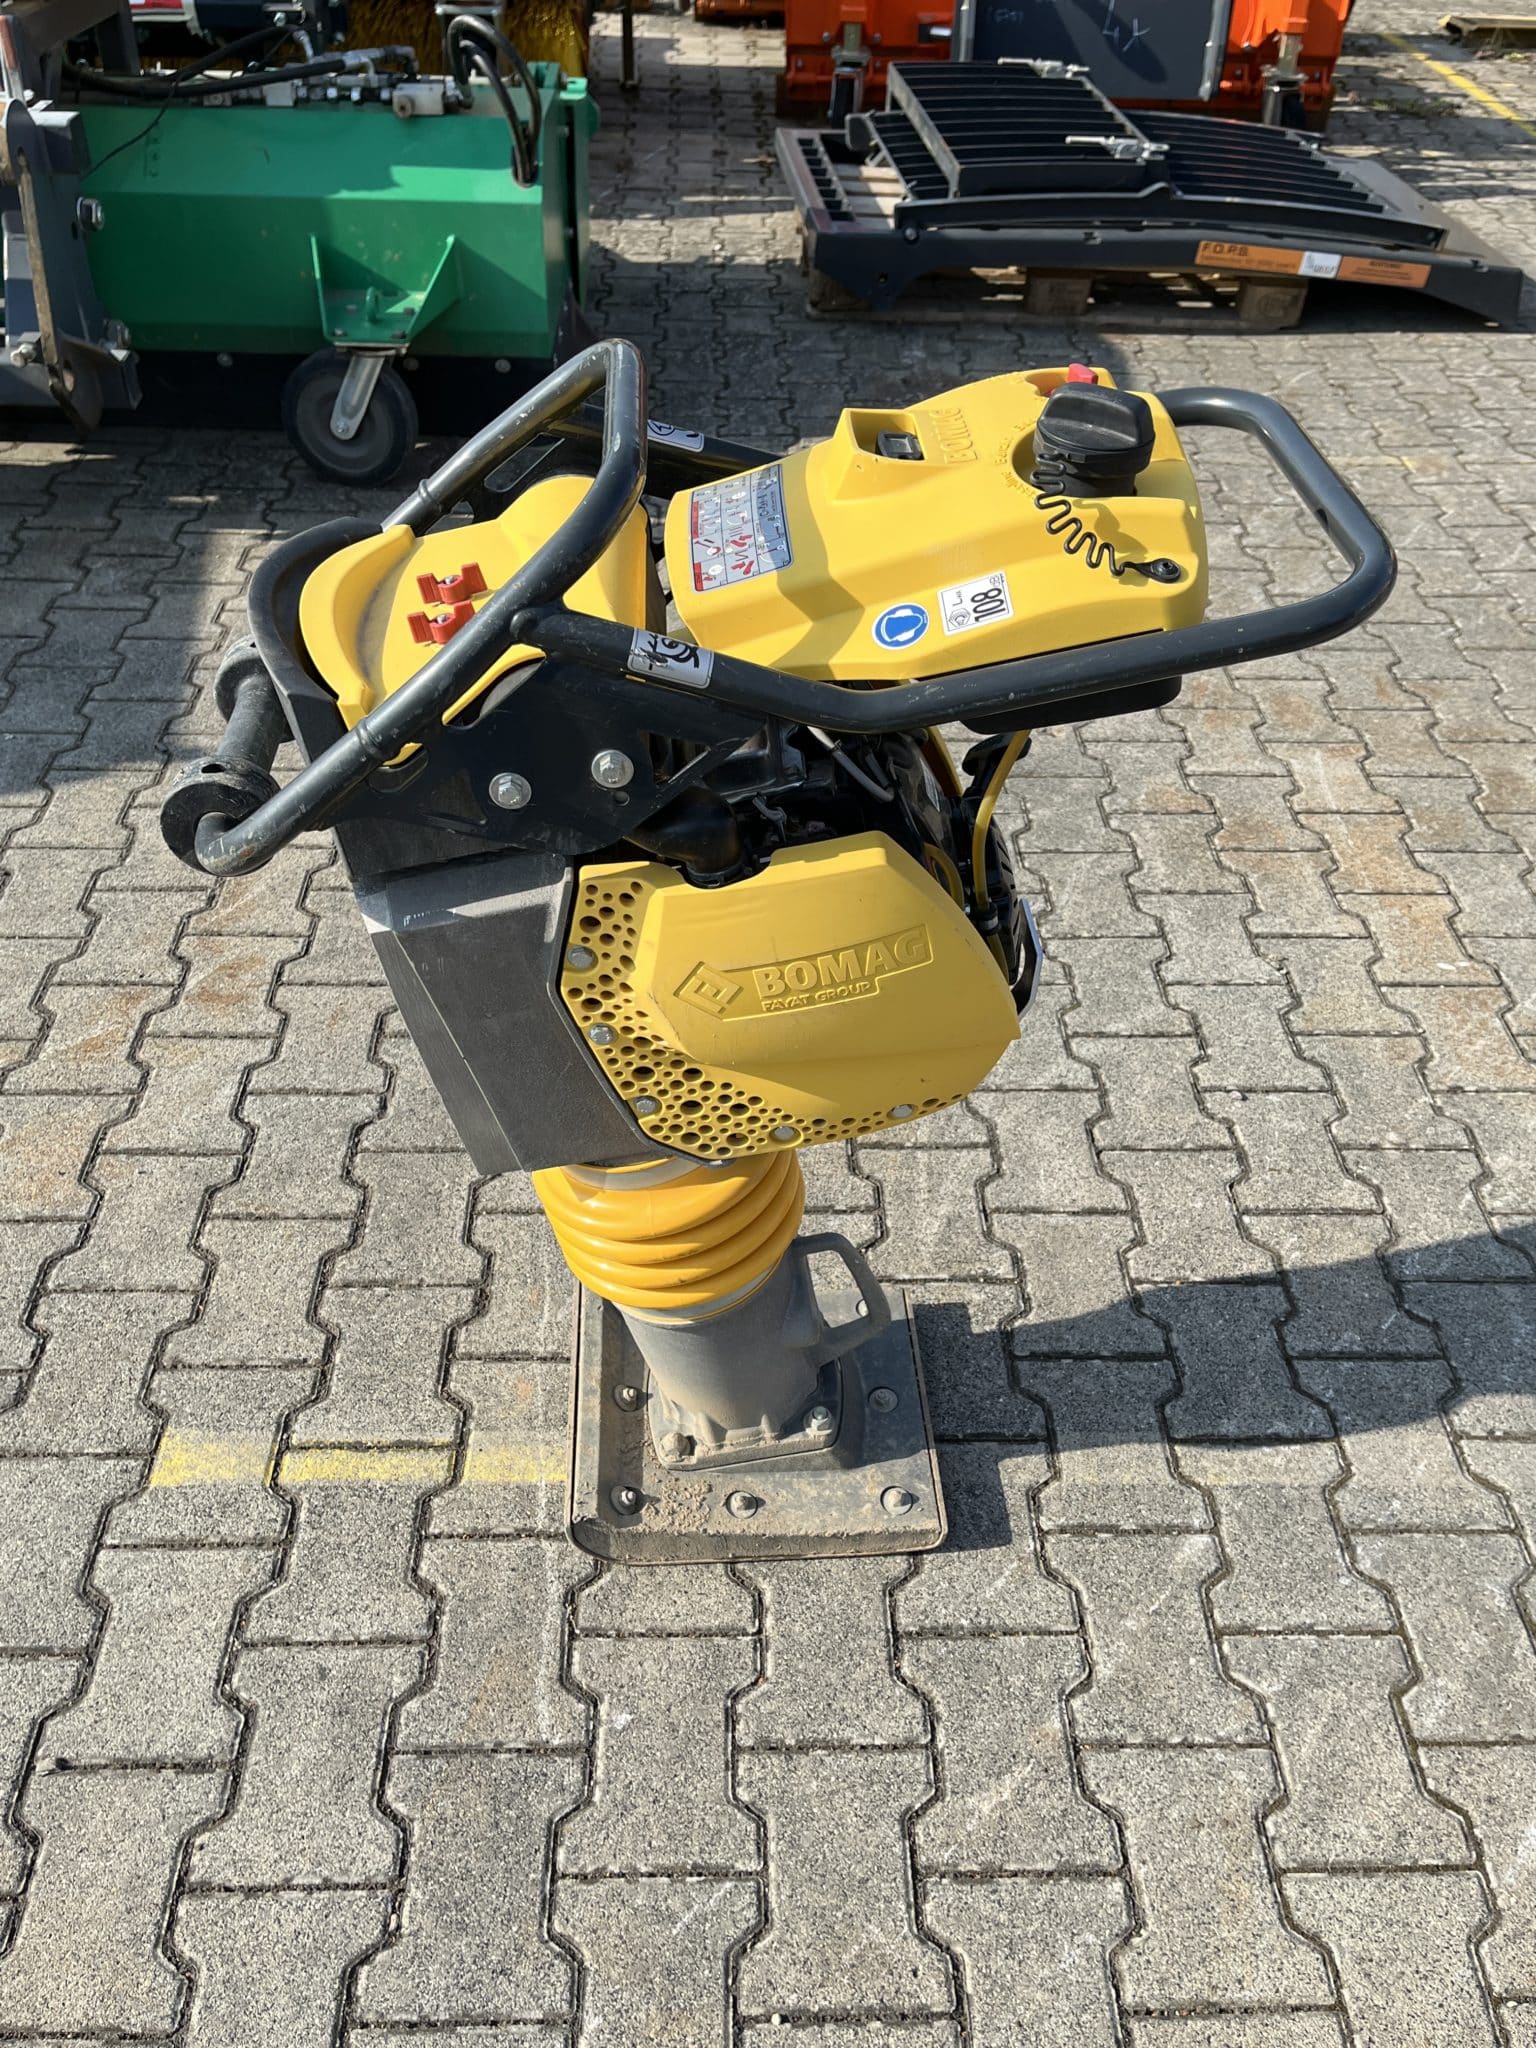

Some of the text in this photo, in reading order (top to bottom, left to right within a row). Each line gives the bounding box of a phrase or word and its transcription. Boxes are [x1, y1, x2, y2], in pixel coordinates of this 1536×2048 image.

[970, 587, 1006, 622] 108
[752, 928, 926, 1000] BOMAG
[761, 981, 872, 1012] FAYAT GROUP
